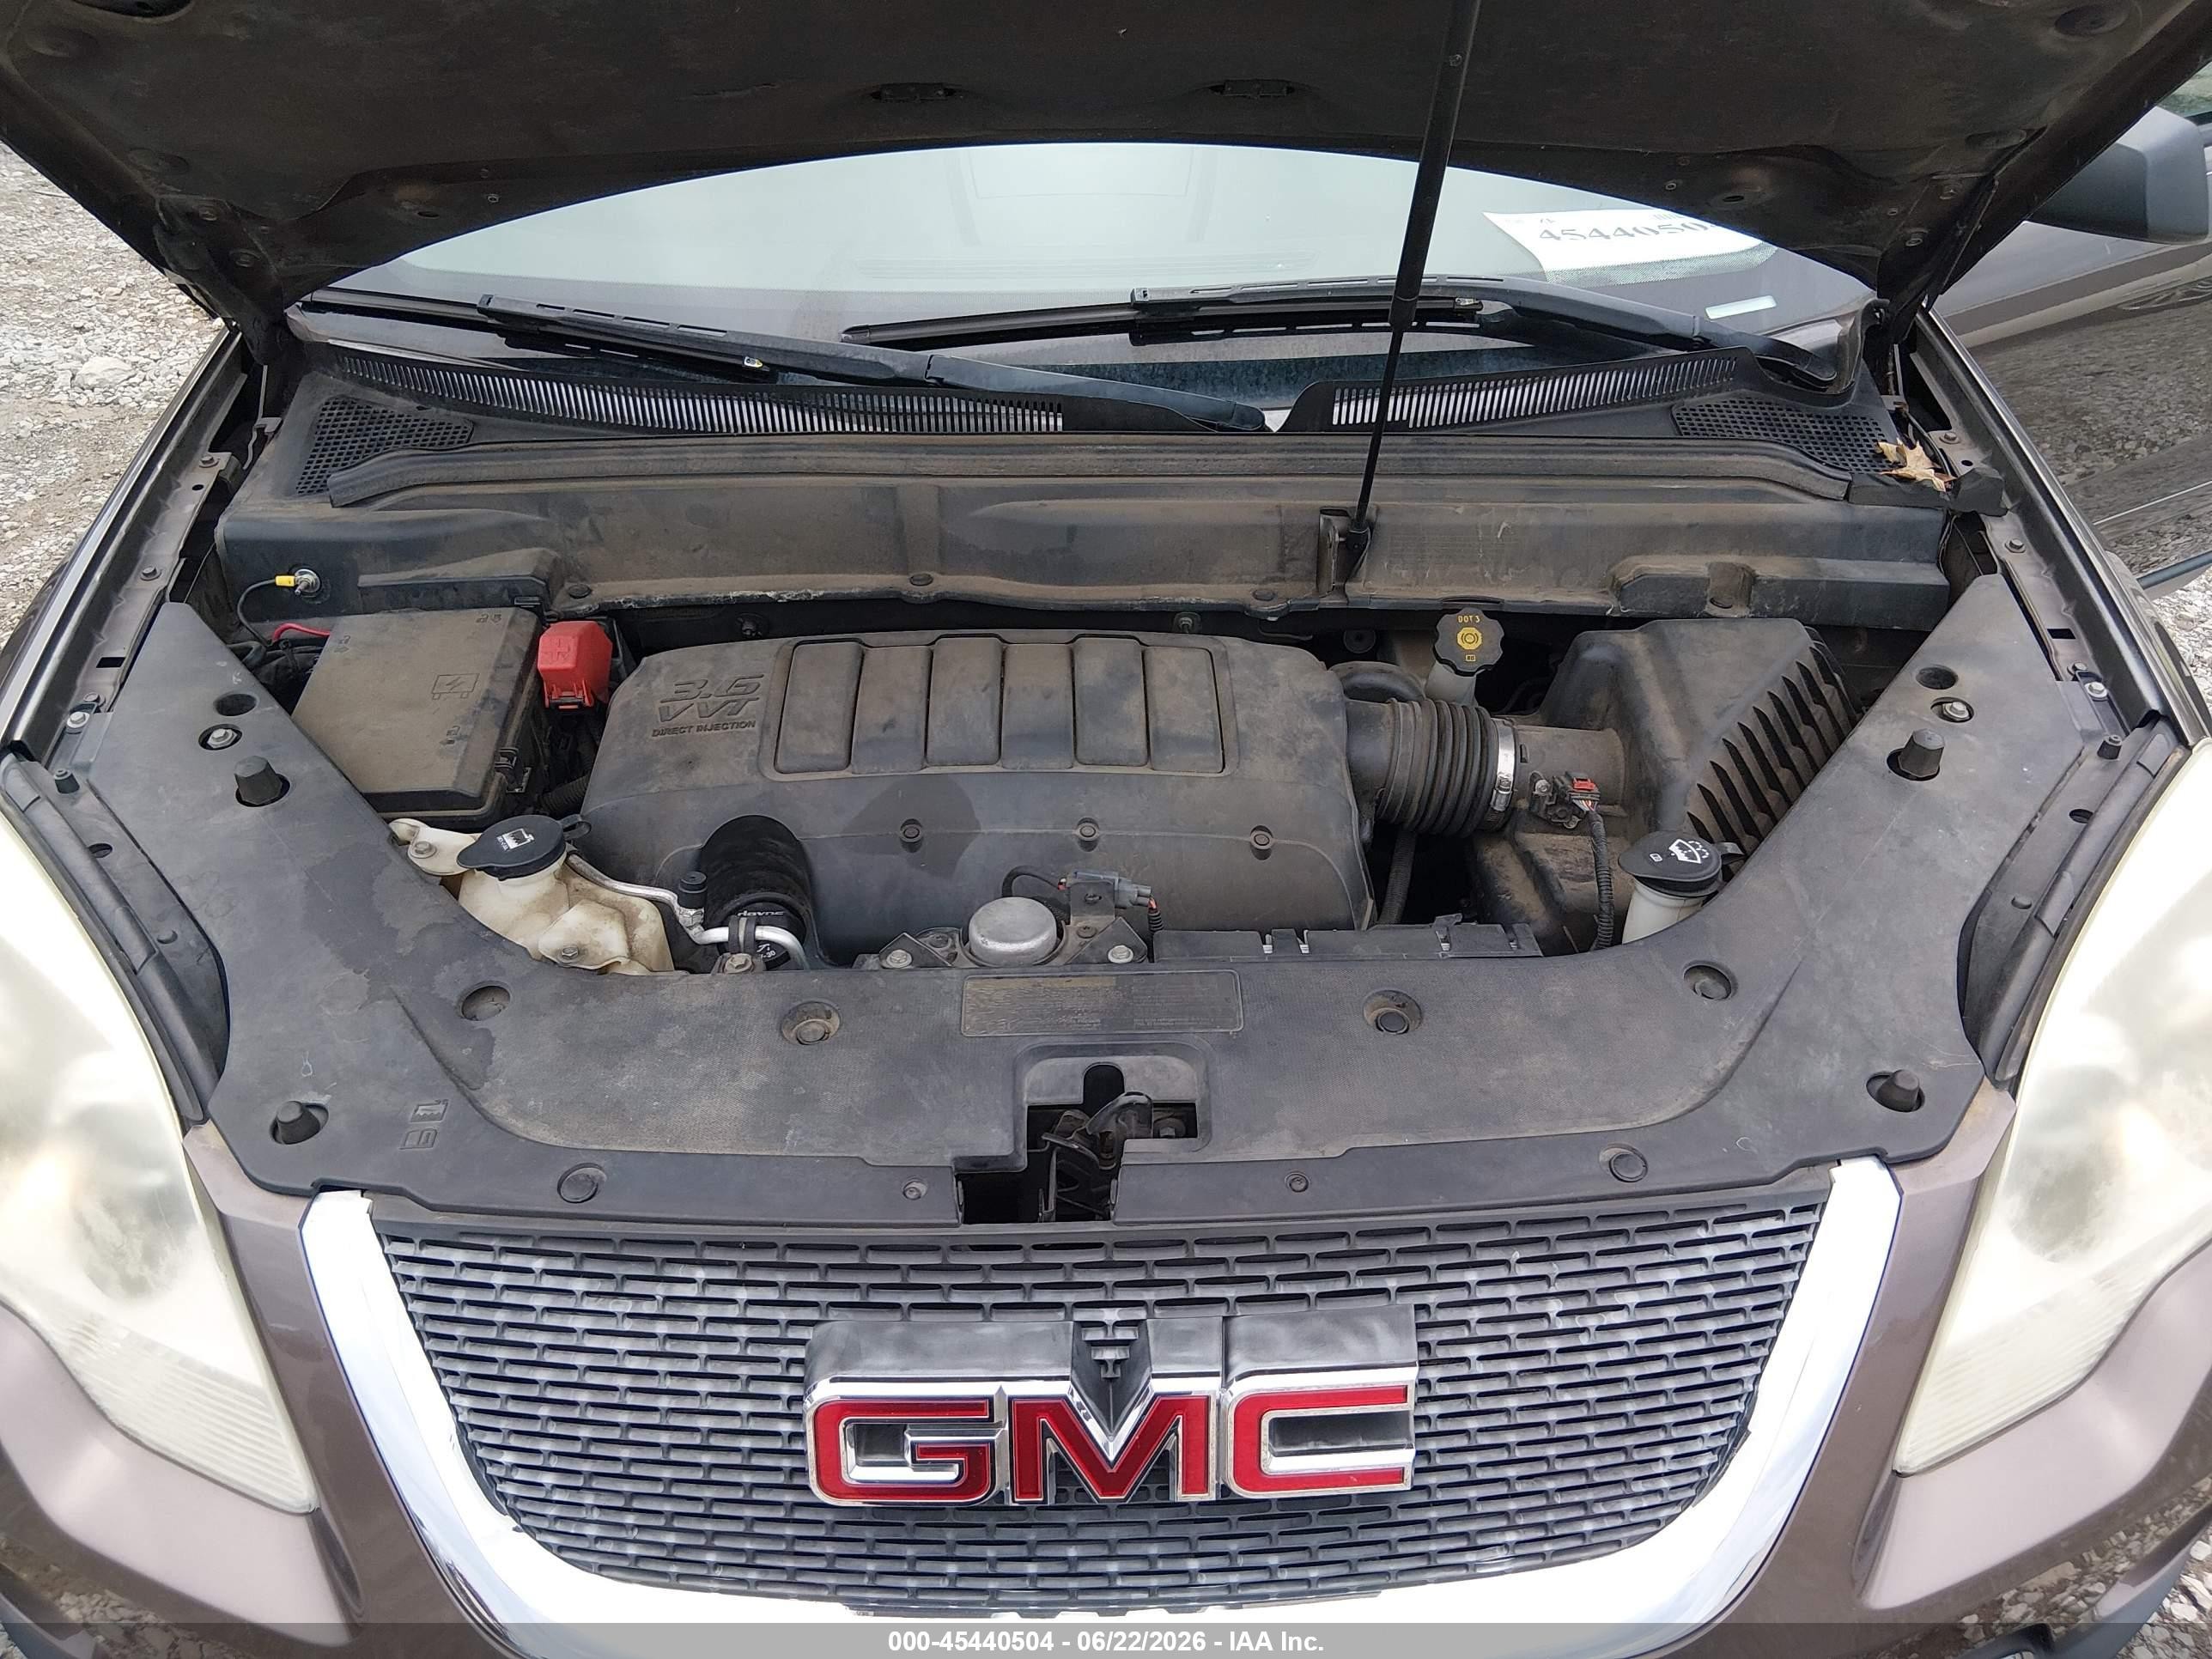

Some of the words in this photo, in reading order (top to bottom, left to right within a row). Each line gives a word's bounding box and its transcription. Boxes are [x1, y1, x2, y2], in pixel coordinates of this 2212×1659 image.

[1539, 222, 1716, 240] 4544050
[659, 673, 764, 703] 3.6
[658, 696, 760, 722] VVT
[652, 725, 693, 738] DIRECT
[696, 720, 756, 733] INJECTION
[805, 1364, 1418, 1507] GMC
